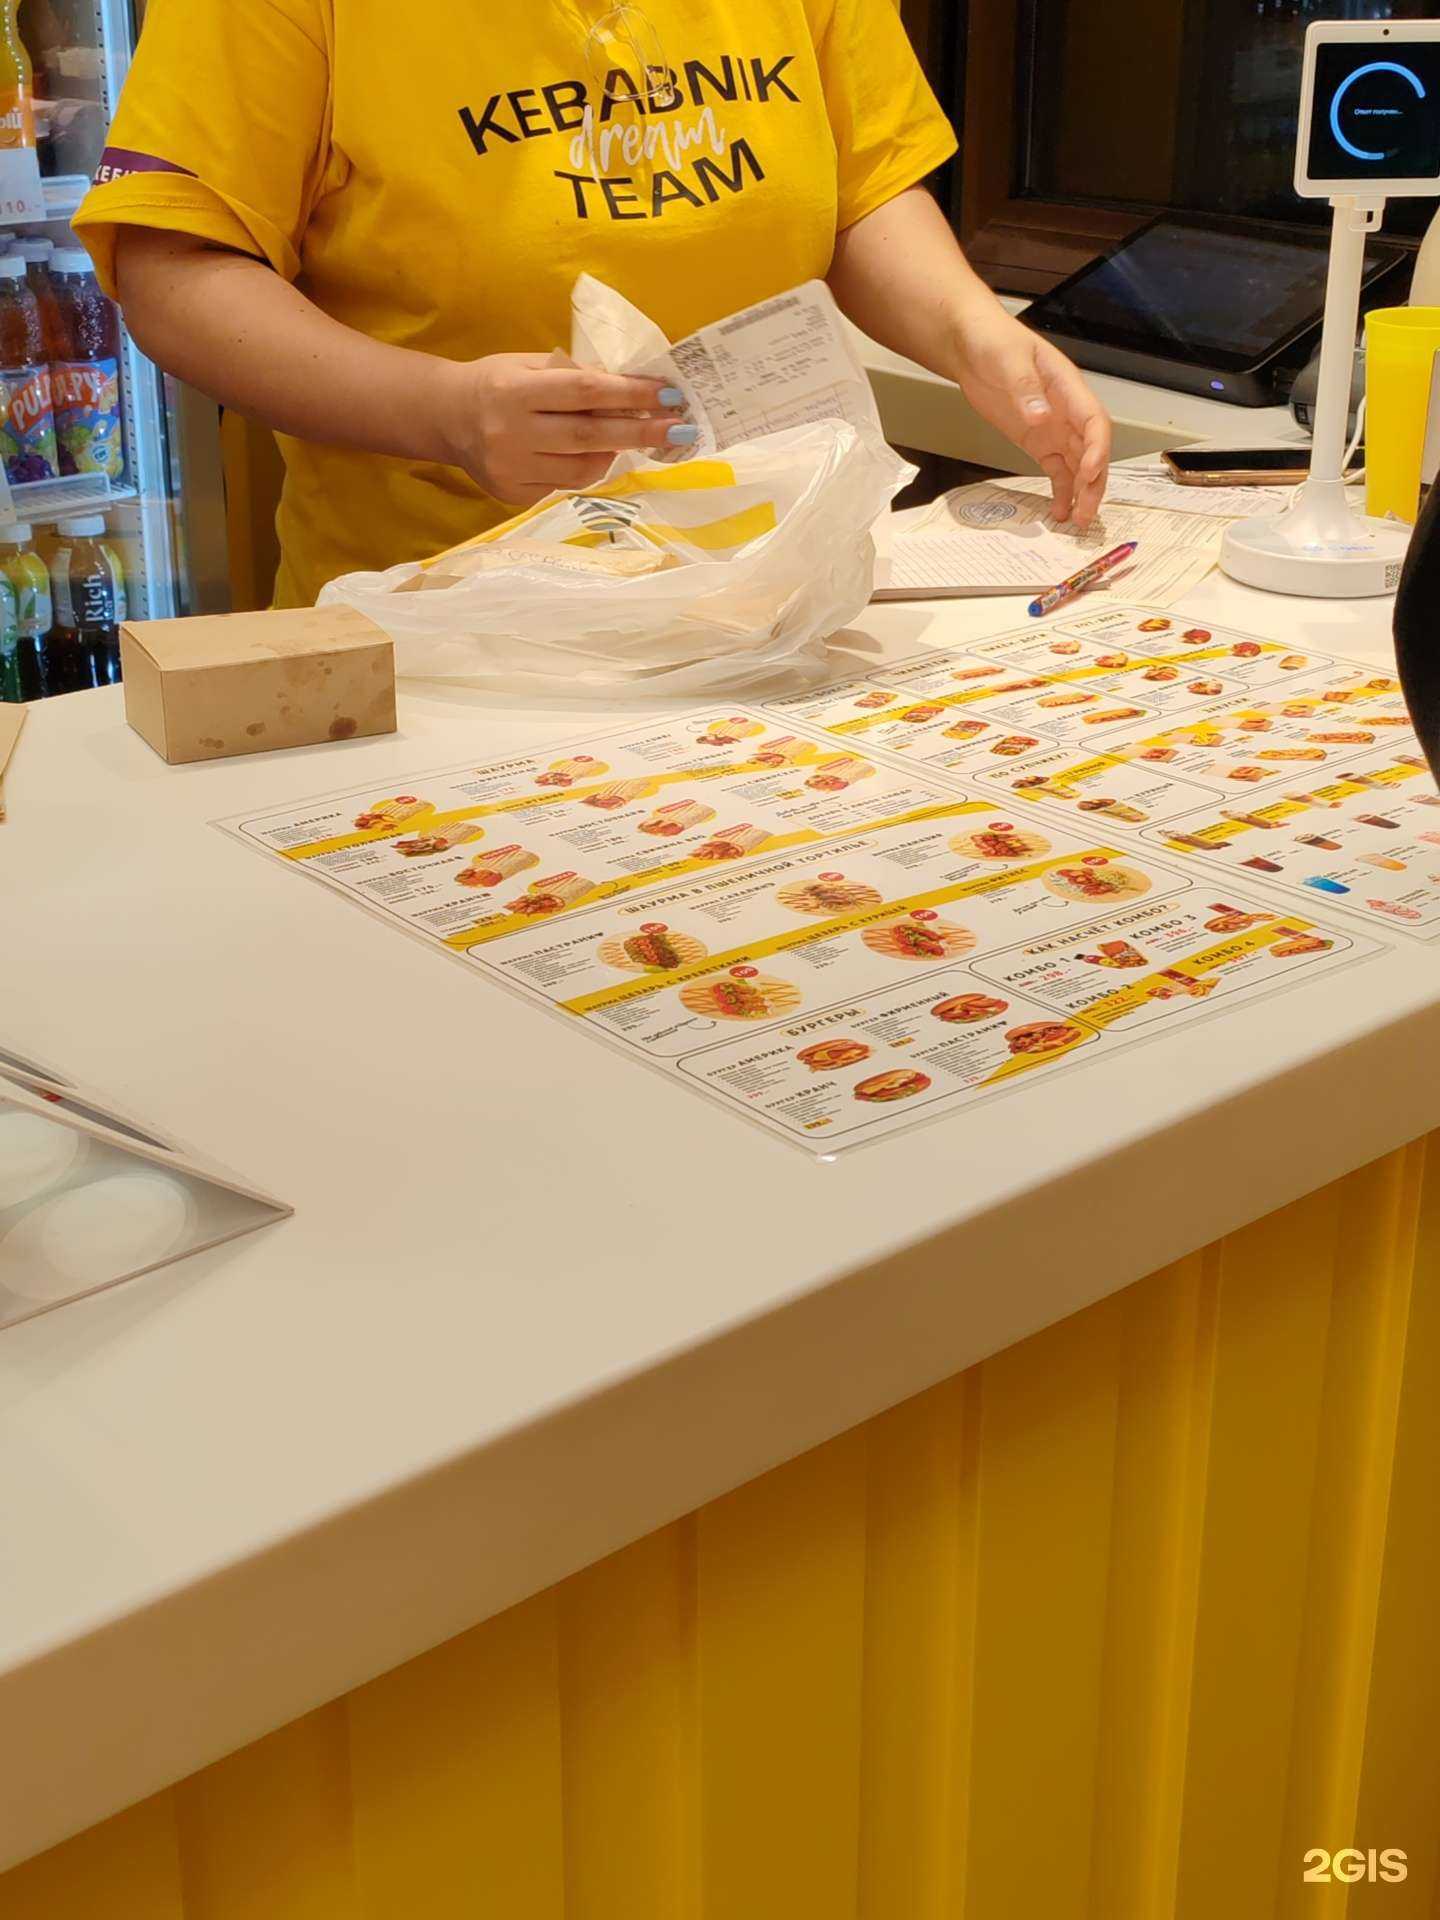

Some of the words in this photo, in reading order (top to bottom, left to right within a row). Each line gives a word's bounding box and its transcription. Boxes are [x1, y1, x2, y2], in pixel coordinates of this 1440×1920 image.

[458, 55, 800, 155] KEBABNIK
[569, 104, 725, 183] dream
[554, 138, 765, 221] TEAM
[84, 573, 104, 622] Rich
[624, 893, 690, 913] ШАУРМА
[704, 861, 794, 890] ПШЕНИЧНОЙ
[796, 841, 869, 863] ТОРТИЛЬЕ
[1025, 943, 1058, 955] КАК
[1056, 924, 1111, 945] НАСЧЁТ
[1113, 904, 1168, 926] КОМБО?
[1129, 920, 1183, 939] КОМБО
[1192, 945, 1243, 965] КОМБО
[1003, 962, 1057, 982] КОМБО
[618, 984, 665, 1000] ЦЕЗАРЬ
[879, 992, 950, 1017] ФИРМЕННЫЙ
[1065, 989, 1119, 1009] КОМБО
[786, 1009, 861, 1036] БУРГЕРЫ
[738, 1045, 794, 1066] АМЕРИКА
[795, 1081, 836, 1097] КРАНЧ
